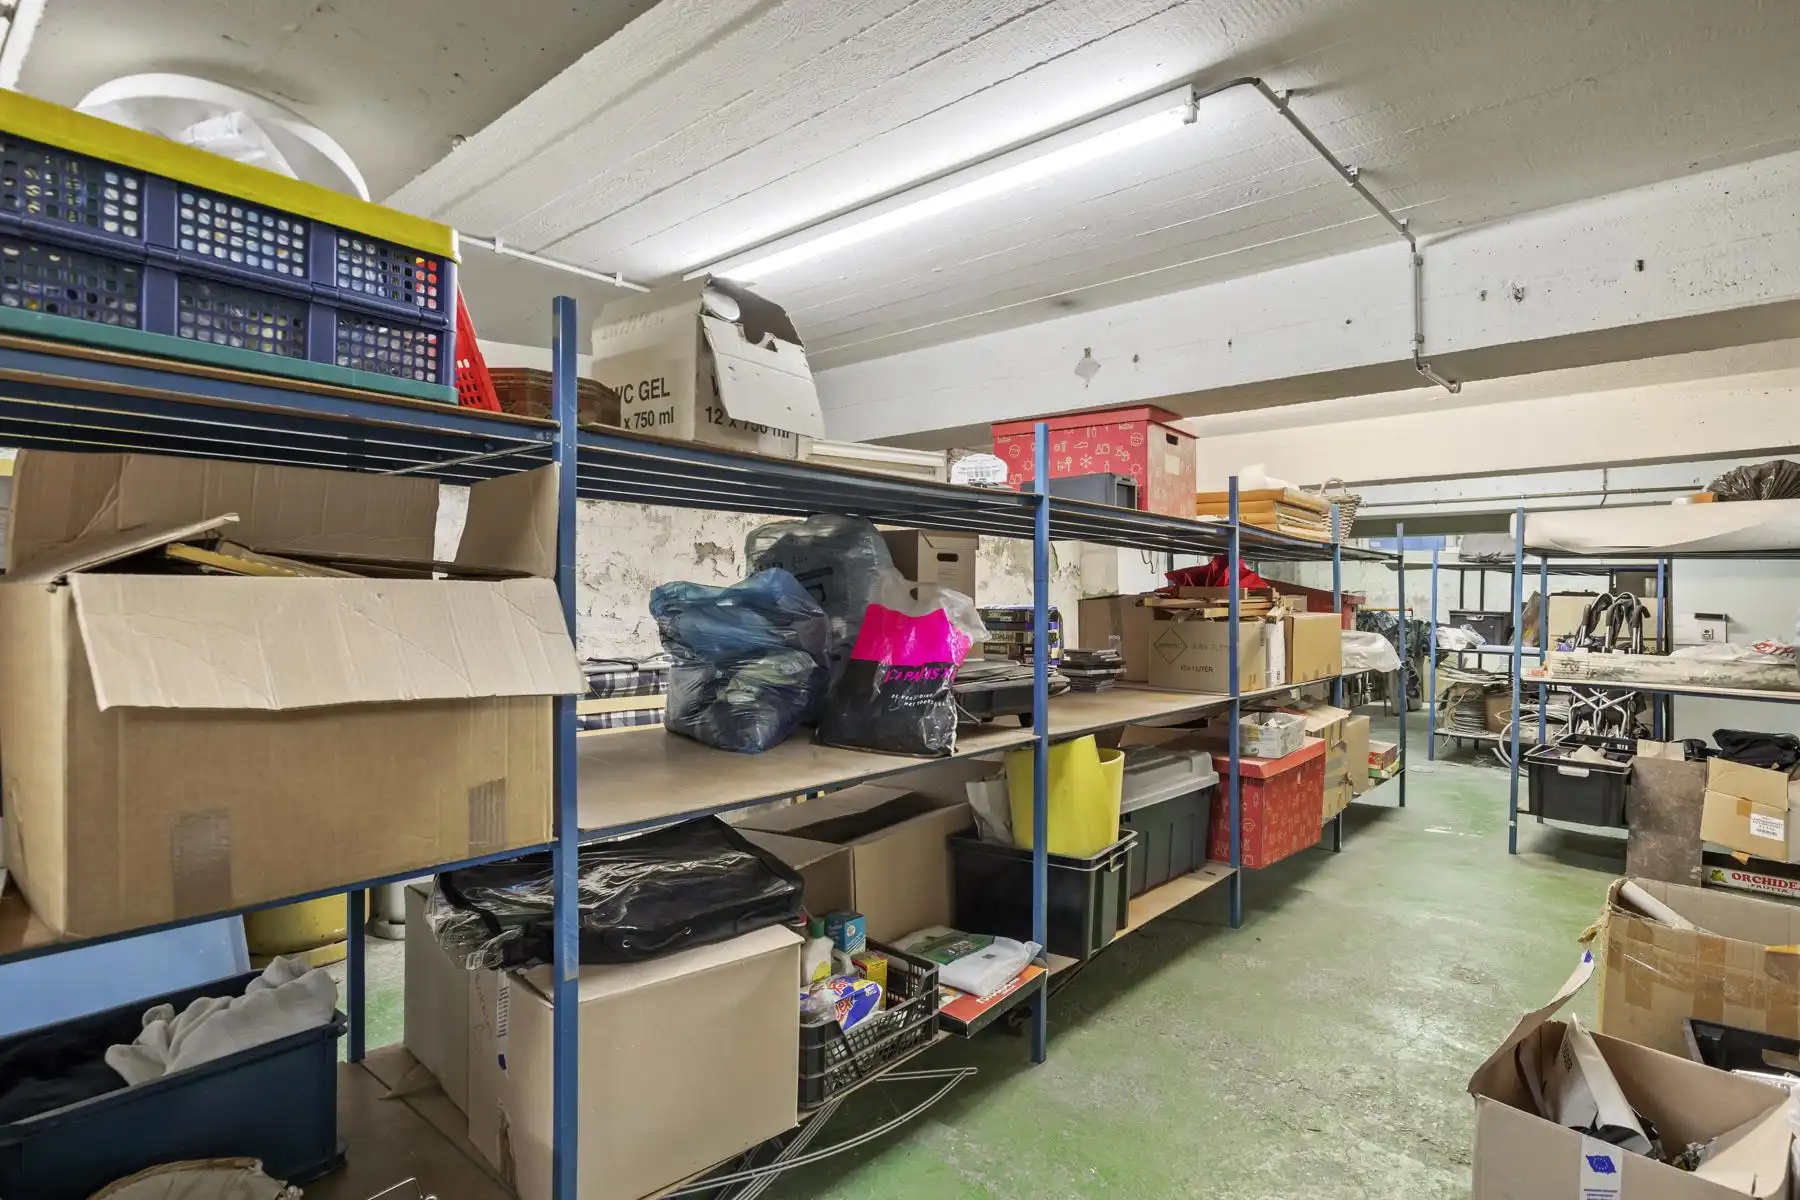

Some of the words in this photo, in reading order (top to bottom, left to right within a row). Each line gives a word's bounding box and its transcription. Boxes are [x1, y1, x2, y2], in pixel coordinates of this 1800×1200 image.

[639, 377, 671, 401] GEL
[624, 417, 631, 430] x
[634, 410, 655, 429] 750
[659, 406, 674, 425] ml
[705, 406, 724, 425] 12
[1731, 872, 1800, 892] ORCHIDE
